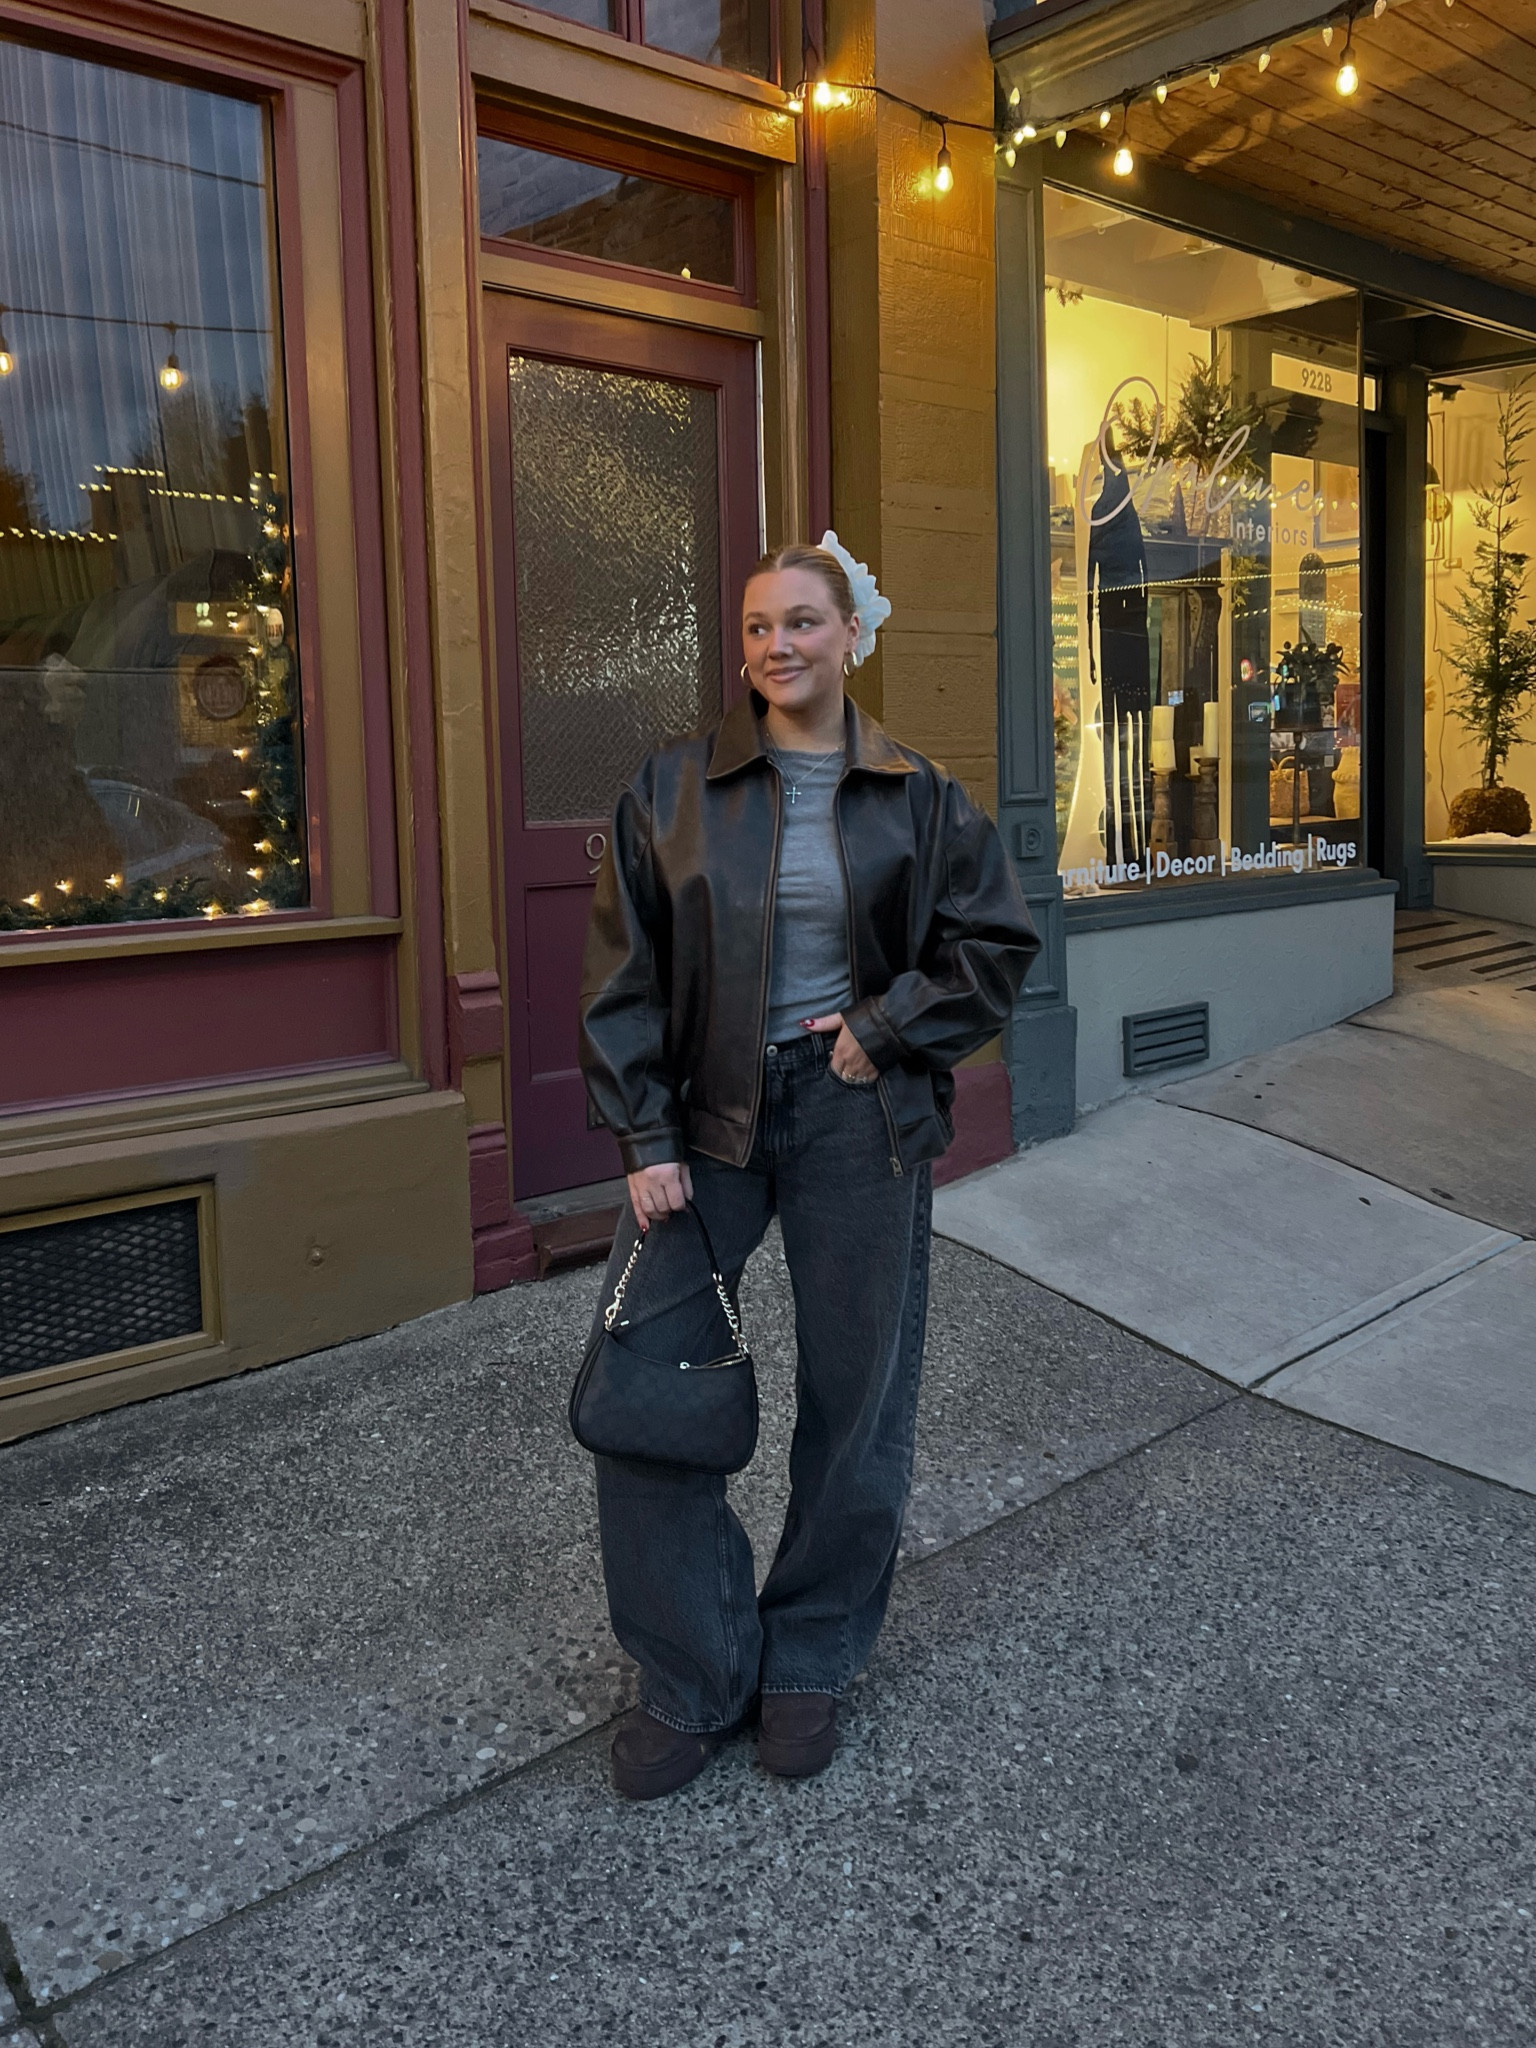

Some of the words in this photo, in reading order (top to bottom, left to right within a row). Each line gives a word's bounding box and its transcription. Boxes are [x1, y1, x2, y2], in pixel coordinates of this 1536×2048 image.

[1301, 367, 1333, 393] 922B
[1230, 513, 1308, 545] Interiors
[1156, 852, 1216, 879] Decor
[1230, 842, 1304, 873] Bedding
[1316, 836, 1357, 867] Rugs
